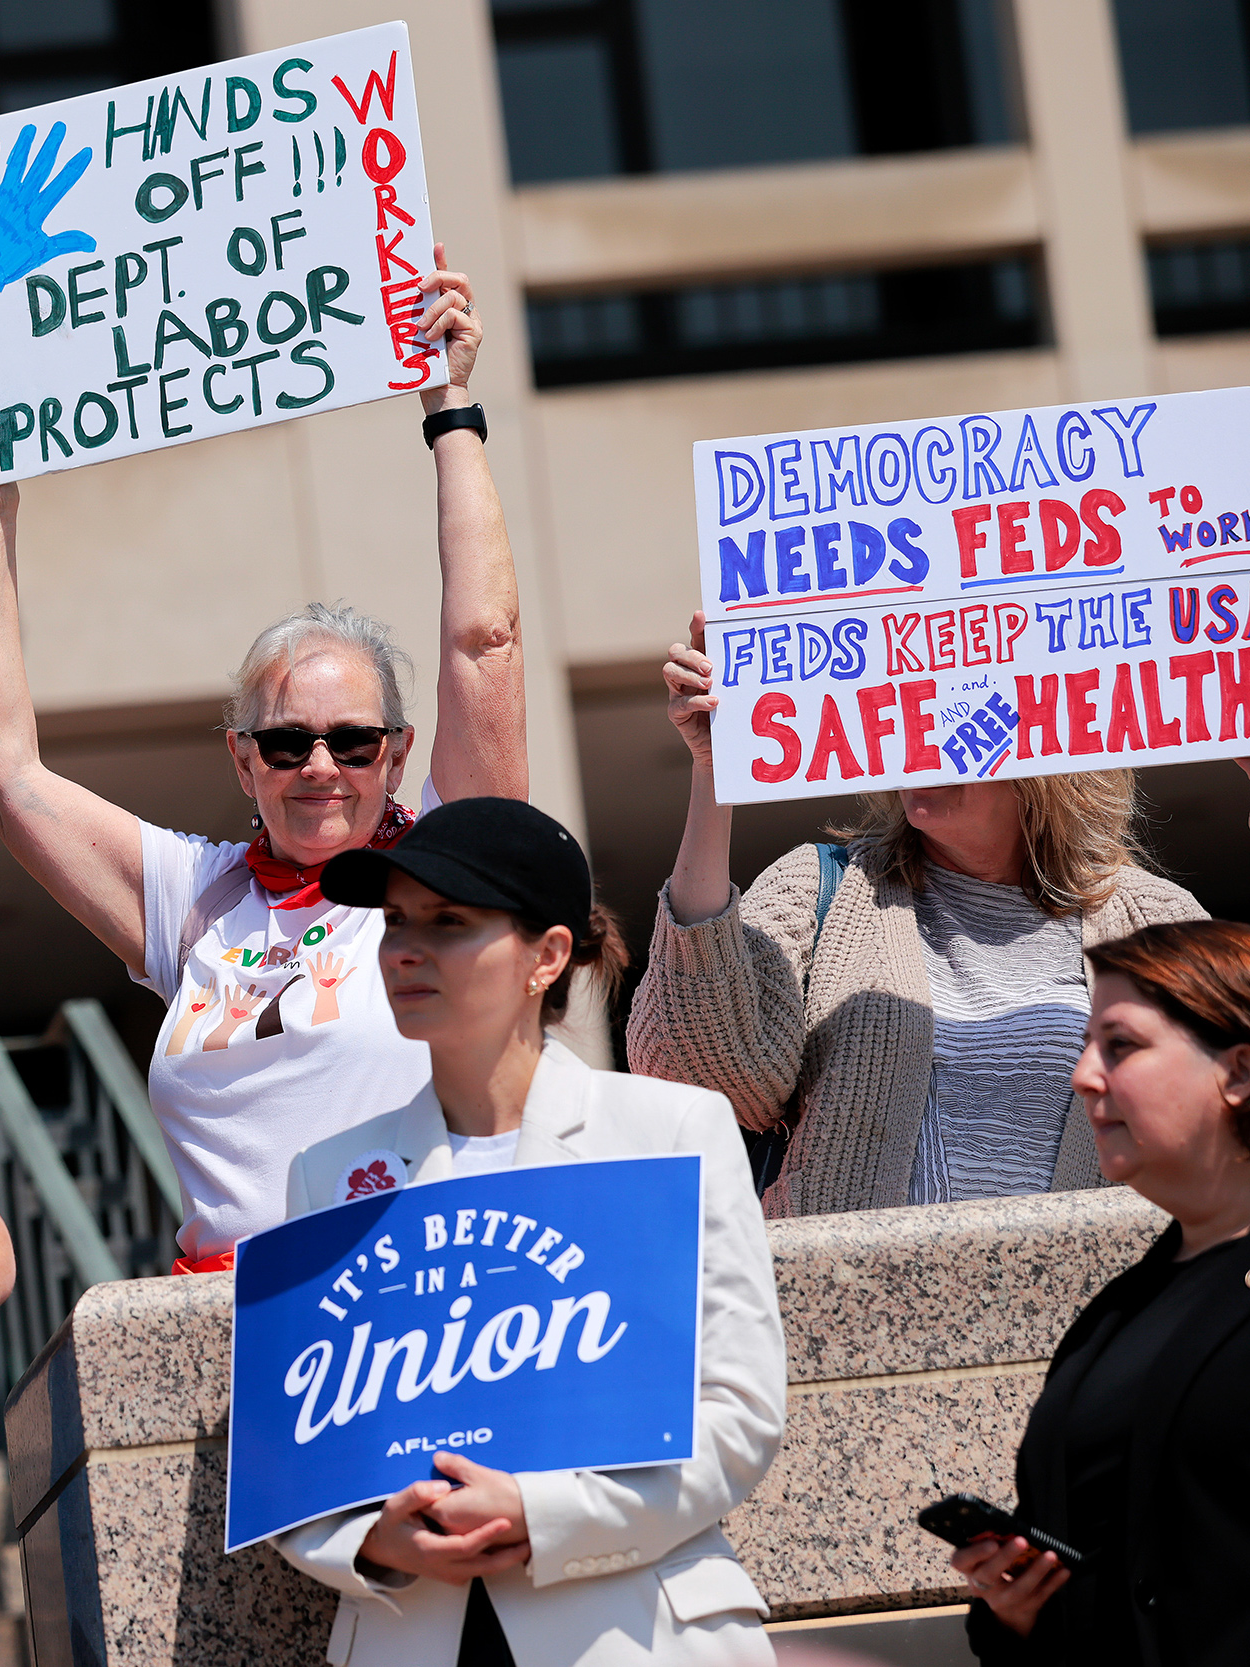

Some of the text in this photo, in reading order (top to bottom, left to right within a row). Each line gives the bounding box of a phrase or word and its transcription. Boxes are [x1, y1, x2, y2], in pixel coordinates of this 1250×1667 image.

[135, 125, 347, 224] OFF !!!
[330, 49, 441, 392] WORKERS
[25, 209, 308, 338] DEPT. OF
[111, 265, 366, 378] LABOR
[714, 402, 1158, 528] DEMOCRACY
[1149, 485, 1204, 519] TO
[718, 488, 1127, 603] NEEDS FEDS
[721, 581, 1250, 688] FEDS KEEP THE US
[961, 674, 989, 691] and
[750, 678, 943, 784] SAFE
[940, 701, 970, 728] AND
[942, 691, 1022, 775] FREE
[414, 1261, 478, 1297] IN A
[422, 1207, 586, 1284] BETTER
[283, 1290, 629, 1446] Union
[385, 1426, 493, 1459] AFL-CIO
